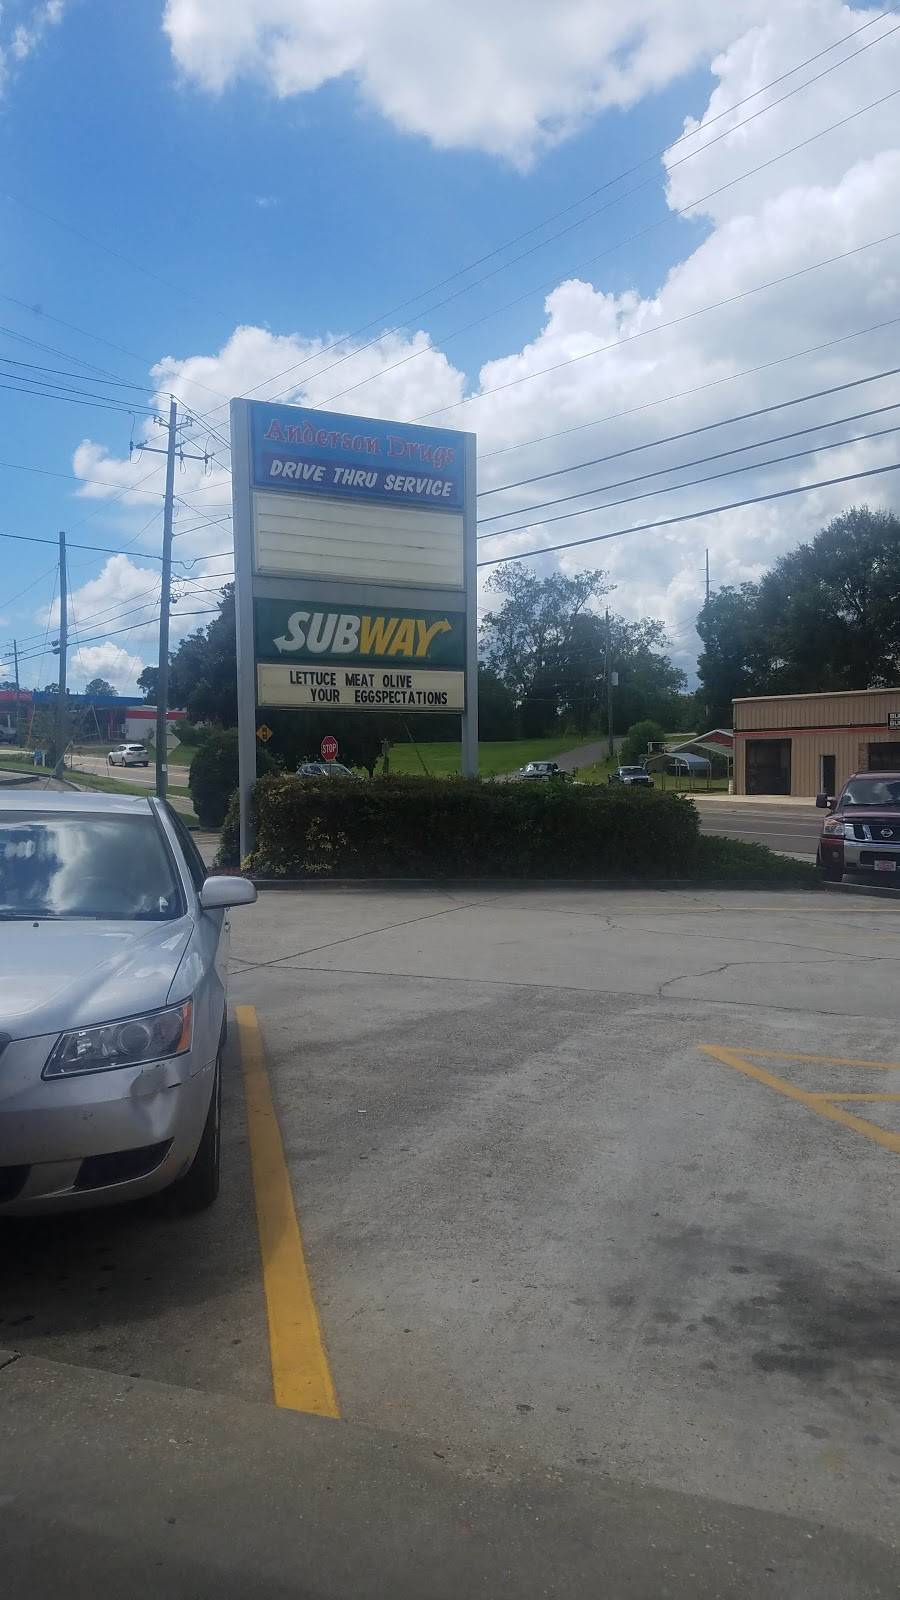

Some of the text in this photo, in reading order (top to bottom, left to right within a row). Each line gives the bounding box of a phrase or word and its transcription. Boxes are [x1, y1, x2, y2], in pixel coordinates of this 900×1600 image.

[264, 418, 455, 470] Anderson Drugs
[270, 459, 453, 497] DRIVE THRU SERVICE
[273, 611, 451, 657] SUBWAY
[290, 670, 412, 688] LETTUCE MEAT OLIVE
[311, 688, 448, 705] YOUR EGGSPECTATIONS
[322, 744, 337, 753] STOP
